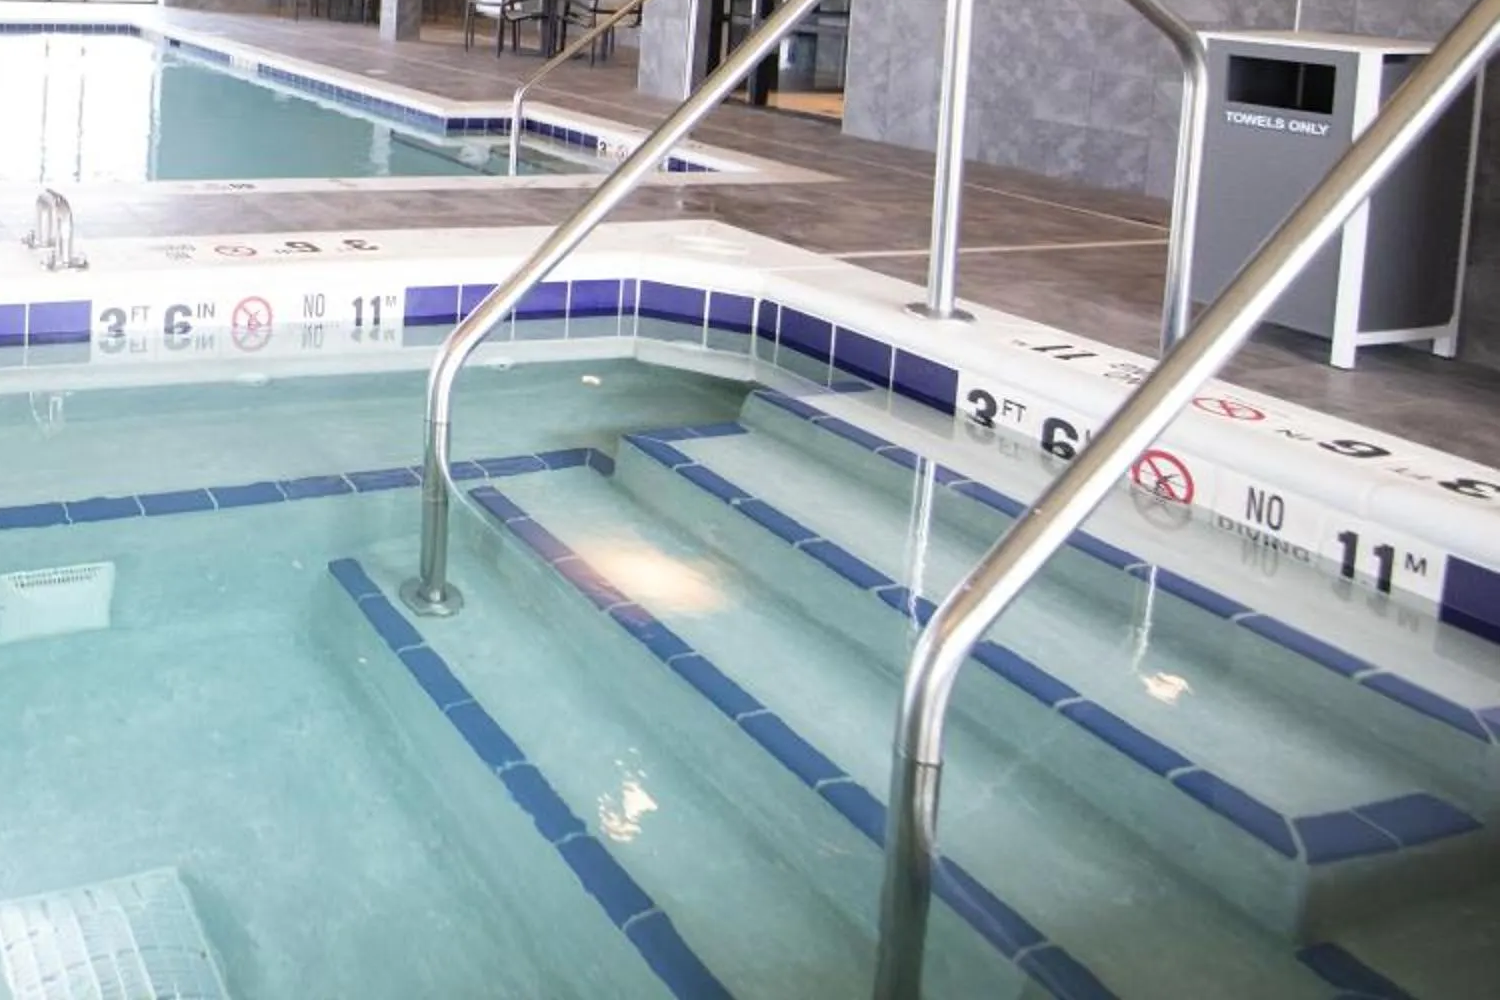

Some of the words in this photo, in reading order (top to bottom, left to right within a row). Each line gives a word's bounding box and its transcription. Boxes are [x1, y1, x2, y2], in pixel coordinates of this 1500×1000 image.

[1225, 111, 1285, 130] TOWELS
[1288, 119, 1330, 136] ONLY
[131, 306, 150, 322] FT
[197, 302, 216, 318] IN
[303, 293, 325, 317] NO
[967, 388, 997, 428] 3
[1002, 397, 1027, 423] FT
[1041, 416, 1079, 460] 6
[1245, 486, 1285, 531] NO
[1404, 551, 1428, 577] M
